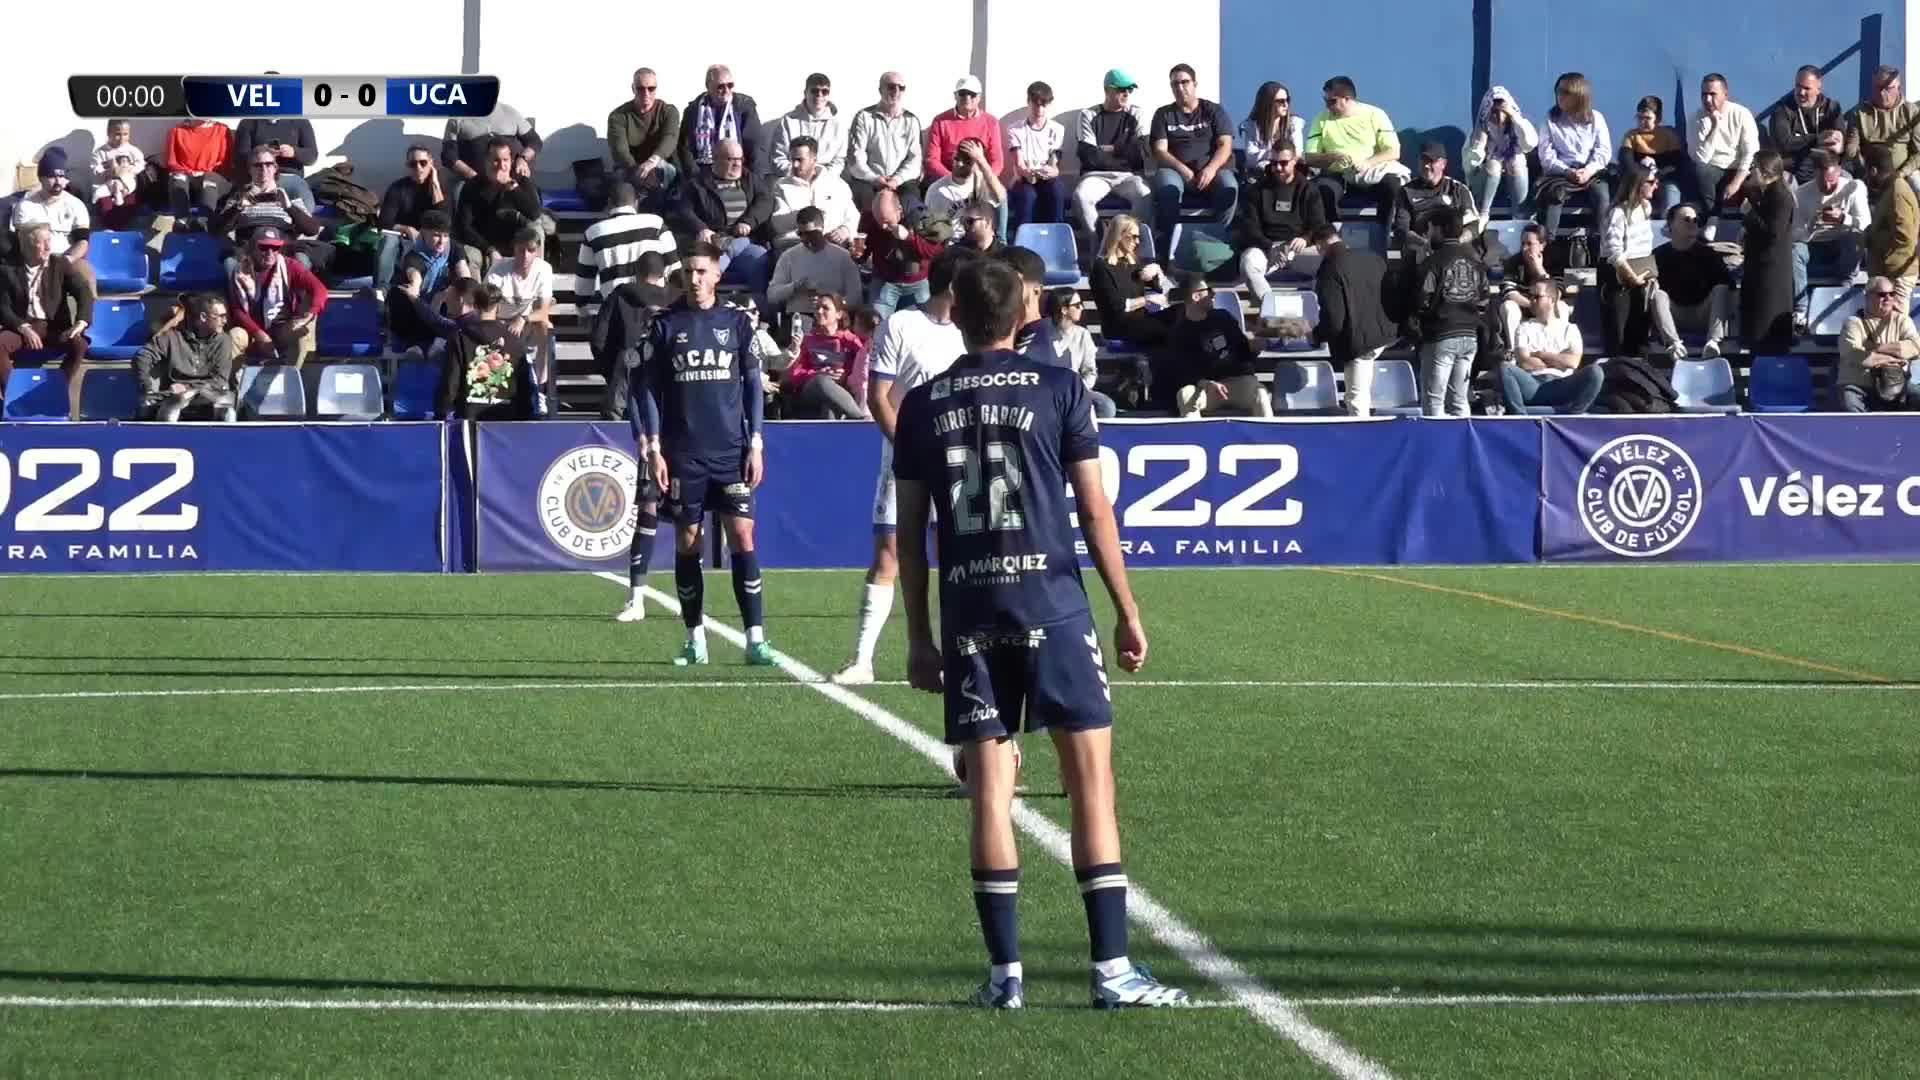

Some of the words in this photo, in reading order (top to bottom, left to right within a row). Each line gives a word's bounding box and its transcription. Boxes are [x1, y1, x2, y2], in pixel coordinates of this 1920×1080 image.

[932, 406, 975, 436] JORGE
[980, 404, 1035, 432] GARCÍA
[568, 451, 623, 473] VÉLEZ
[1608, 442, 1671, 466] VÉLEZ
[0, 447, 200, 532] 22
[946, 440, 1025, 536] 22
[1738, 470, 1885, 517] Vélez
[546, 495, 572, 539] CLUB
[572, 534, 593, 552] DE
[600, 506, 639, 551] FÚTBO
[1587, 487, 1615, 535] CLUB
[1614, 529, 1639, 548] DE
[1644, 487, 1693, 547] FÚTBOL
[68, 543, 200, 560] FAMILIA
[1176, 539, 1303, 555] FAMILIA
[968, 553, 1048, 575] MÁRQUEZ
